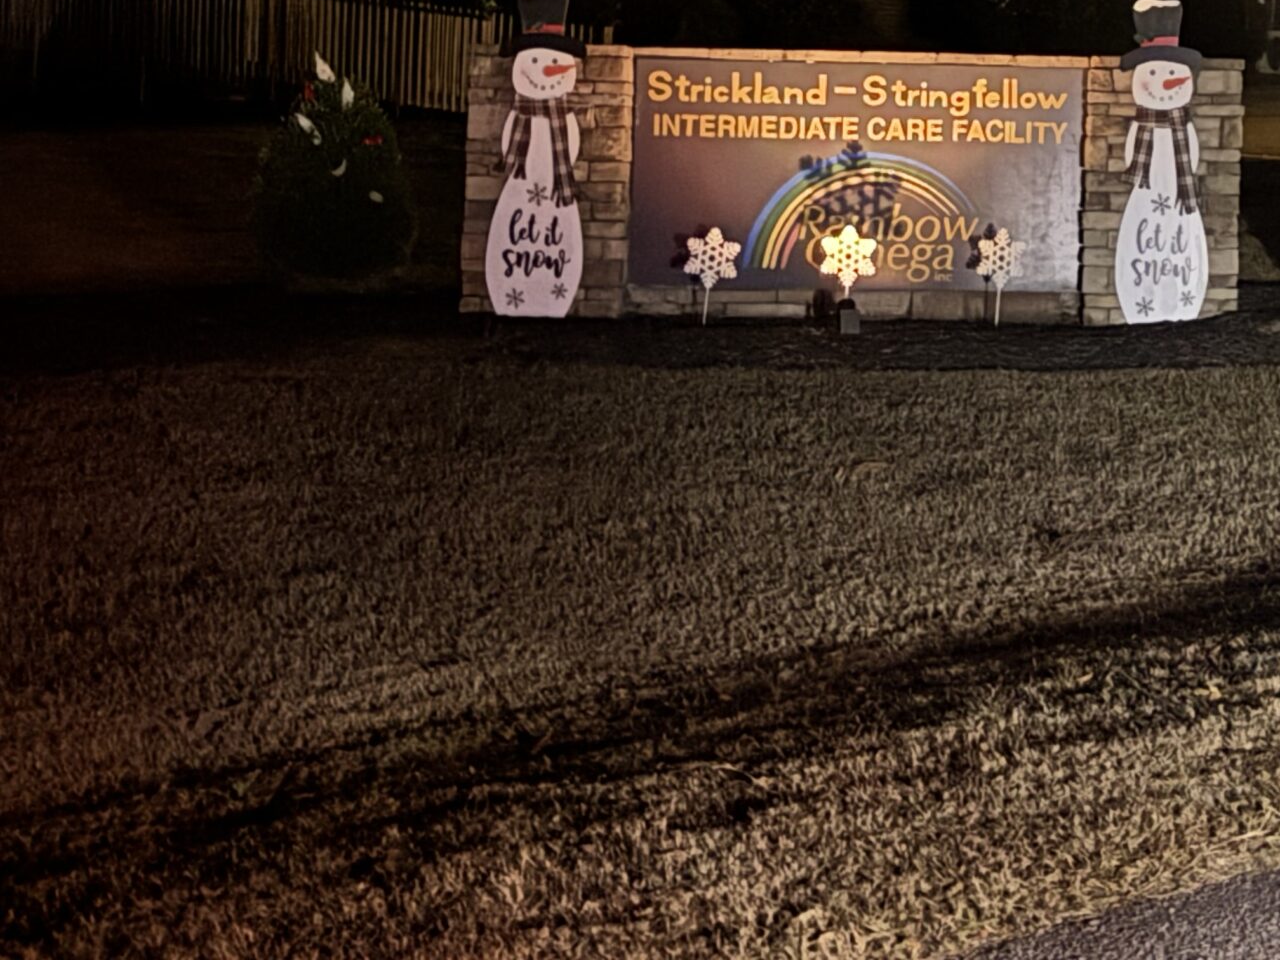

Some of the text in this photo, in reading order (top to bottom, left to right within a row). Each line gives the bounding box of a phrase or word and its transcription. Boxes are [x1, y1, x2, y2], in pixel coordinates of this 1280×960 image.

[652, 113, 1068, 145] INTERMEDIATE CARE FACILITY
[508, 208, 564, 247] let it
[1136, 218, 1188, 255] let it
[502, 248, 571, 279] snow
[805, 236, 954, 283] ega
[1131, 256, 1197, 287] snow
